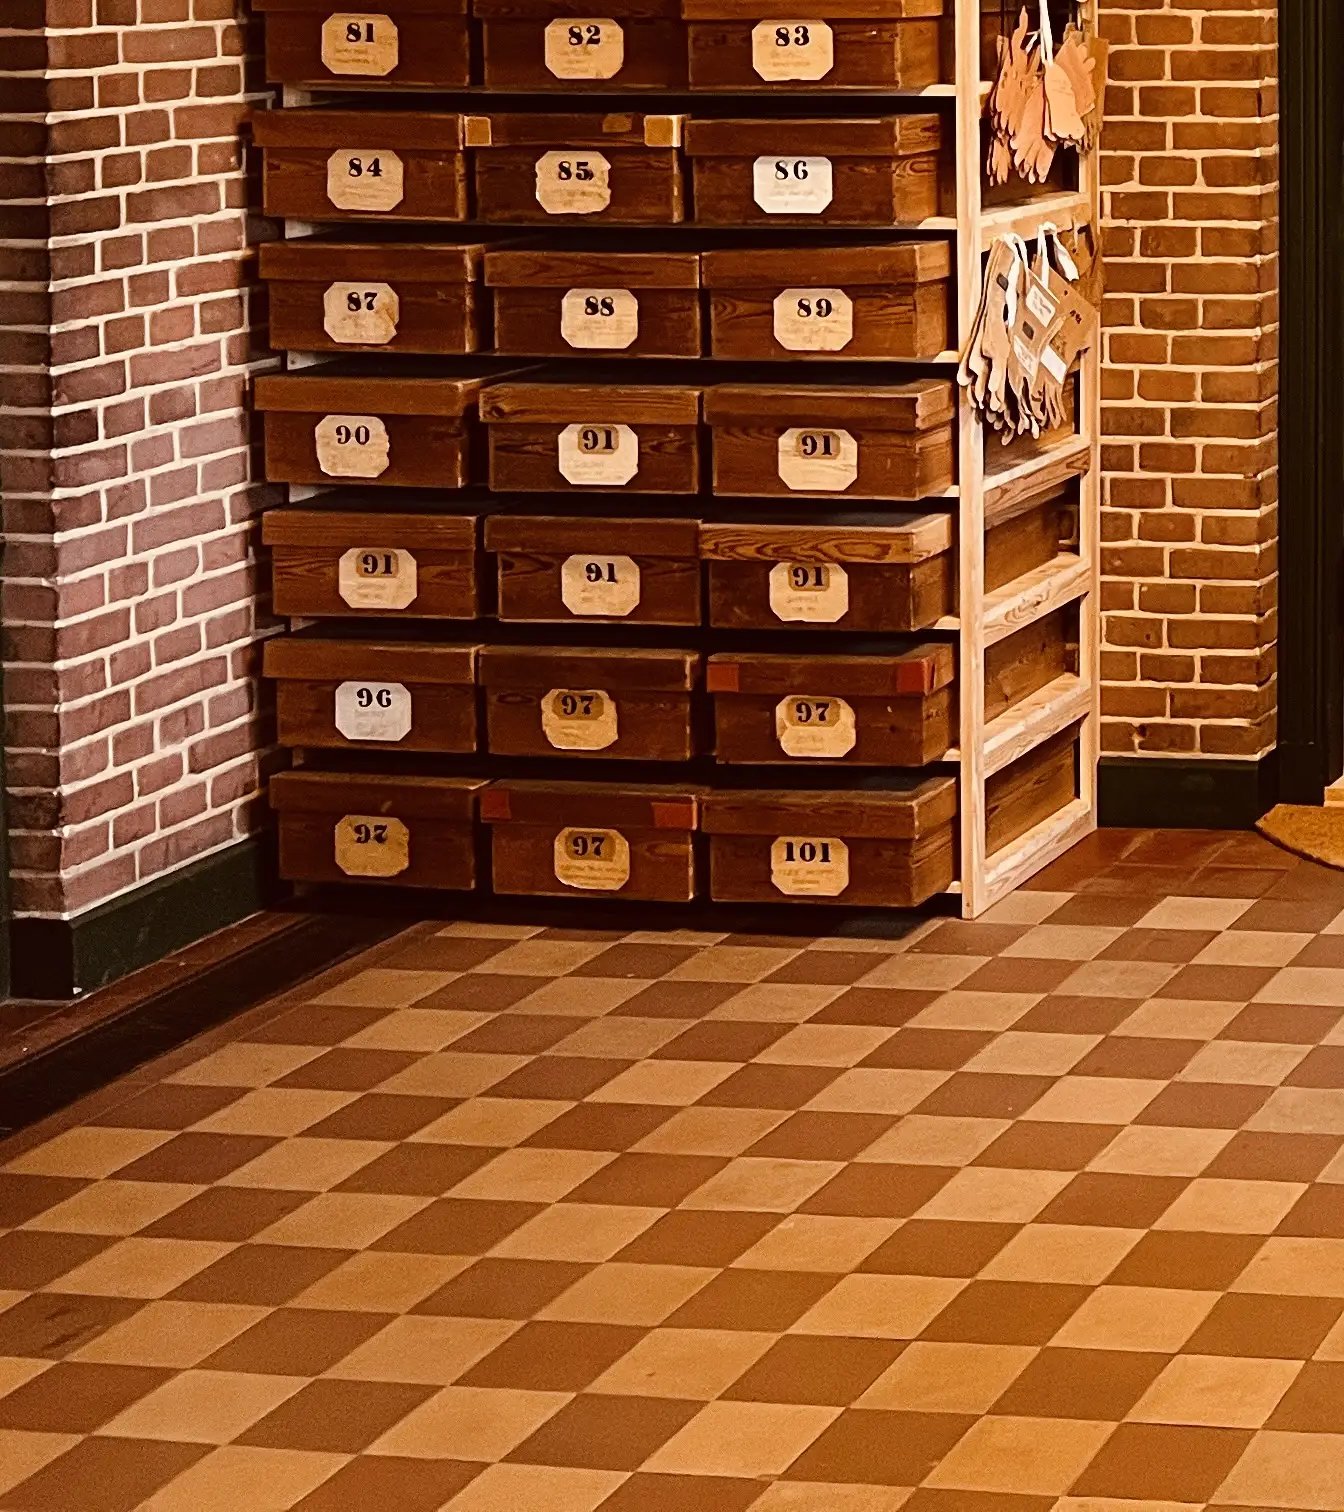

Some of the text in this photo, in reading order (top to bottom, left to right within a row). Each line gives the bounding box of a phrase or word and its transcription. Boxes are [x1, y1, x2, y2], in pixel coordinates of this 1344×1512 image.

[345, 22, 375, 43] 81
[568, 24, 601, 46] 82
[775, 25, 810, 47] 83
[348, 157, 383, 178] 84
[557, 160, 595, 181] 85
[774, 159, 809, 180] 86
[347, 291, 379, 311] 87
[584, 295, 615, 317] 88
[796, 298, 833, 318] 89
[335, 424, 370, 446] 90
[582, 426, 615, 451] 91
[801, 433, 834, 455] 91
[362, 553, 393, 575] 91
[585, 562, 619, 584] 91
[792, 564, 825, 586] 91
[356, 687, 392, 708] 96
[560, 693, 595, 713] 97
[795, 700, 831, 721] 97
[353, 823, 388, 845] 97
[571, 833, 606, 855] 97
[784, 841, 832, 862] 101
